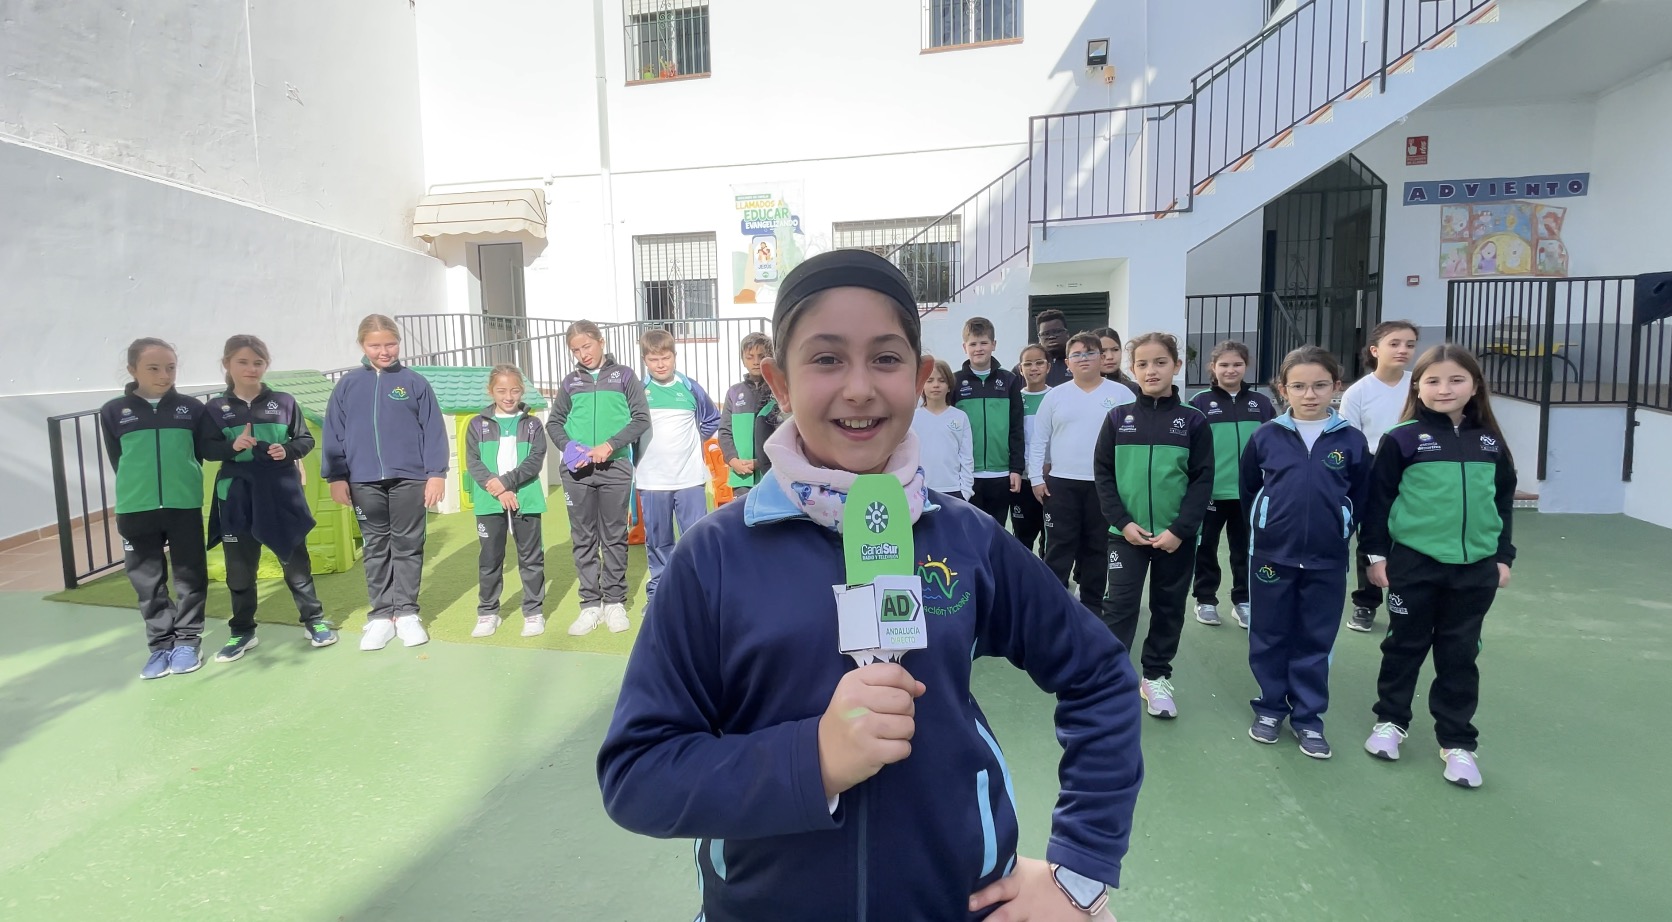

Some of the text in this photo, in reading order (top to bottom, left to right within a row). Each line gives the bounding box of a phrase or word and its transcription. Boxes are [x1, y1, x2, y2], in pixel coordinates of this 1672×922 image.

[1408, 180, 1583, 201] ADVIENTO
[735, 200, 775, 209] LLAMADOS
[744, 207, 789, 220] EDUCAR
[745, 219, 798, 229] EVANGELIZANDO
[883, 594, 910, 617] AD
[886, 626, 920, 635] ANDALUCÍA
[890, 636, 916, 644] DIRECTO
